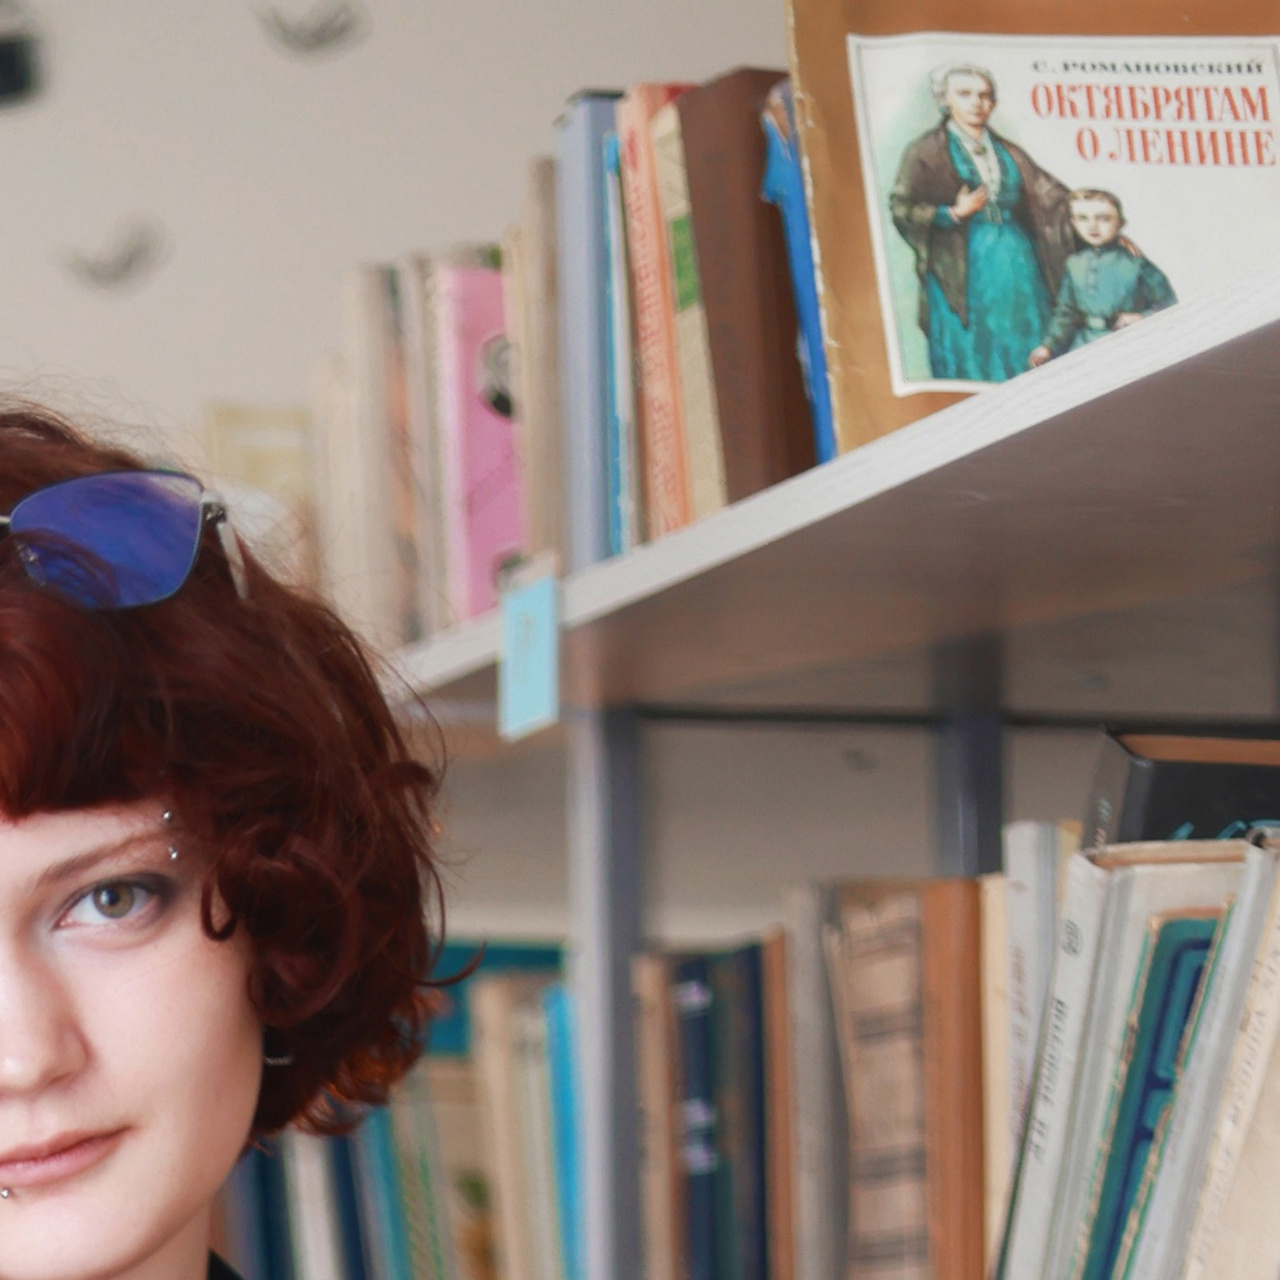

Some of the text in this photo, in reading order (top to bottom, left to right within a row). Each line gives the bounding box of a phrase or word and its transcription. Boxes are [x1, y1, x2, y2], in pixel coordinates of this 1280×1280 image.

[1062, 59, 1263, 75] РОМАНОВСКИЙ
[1030, 81, 1271, 123] ОКТЯБРЯТАМ
[1075, 125, 1277, 167] О ЛЕНИНЕ
